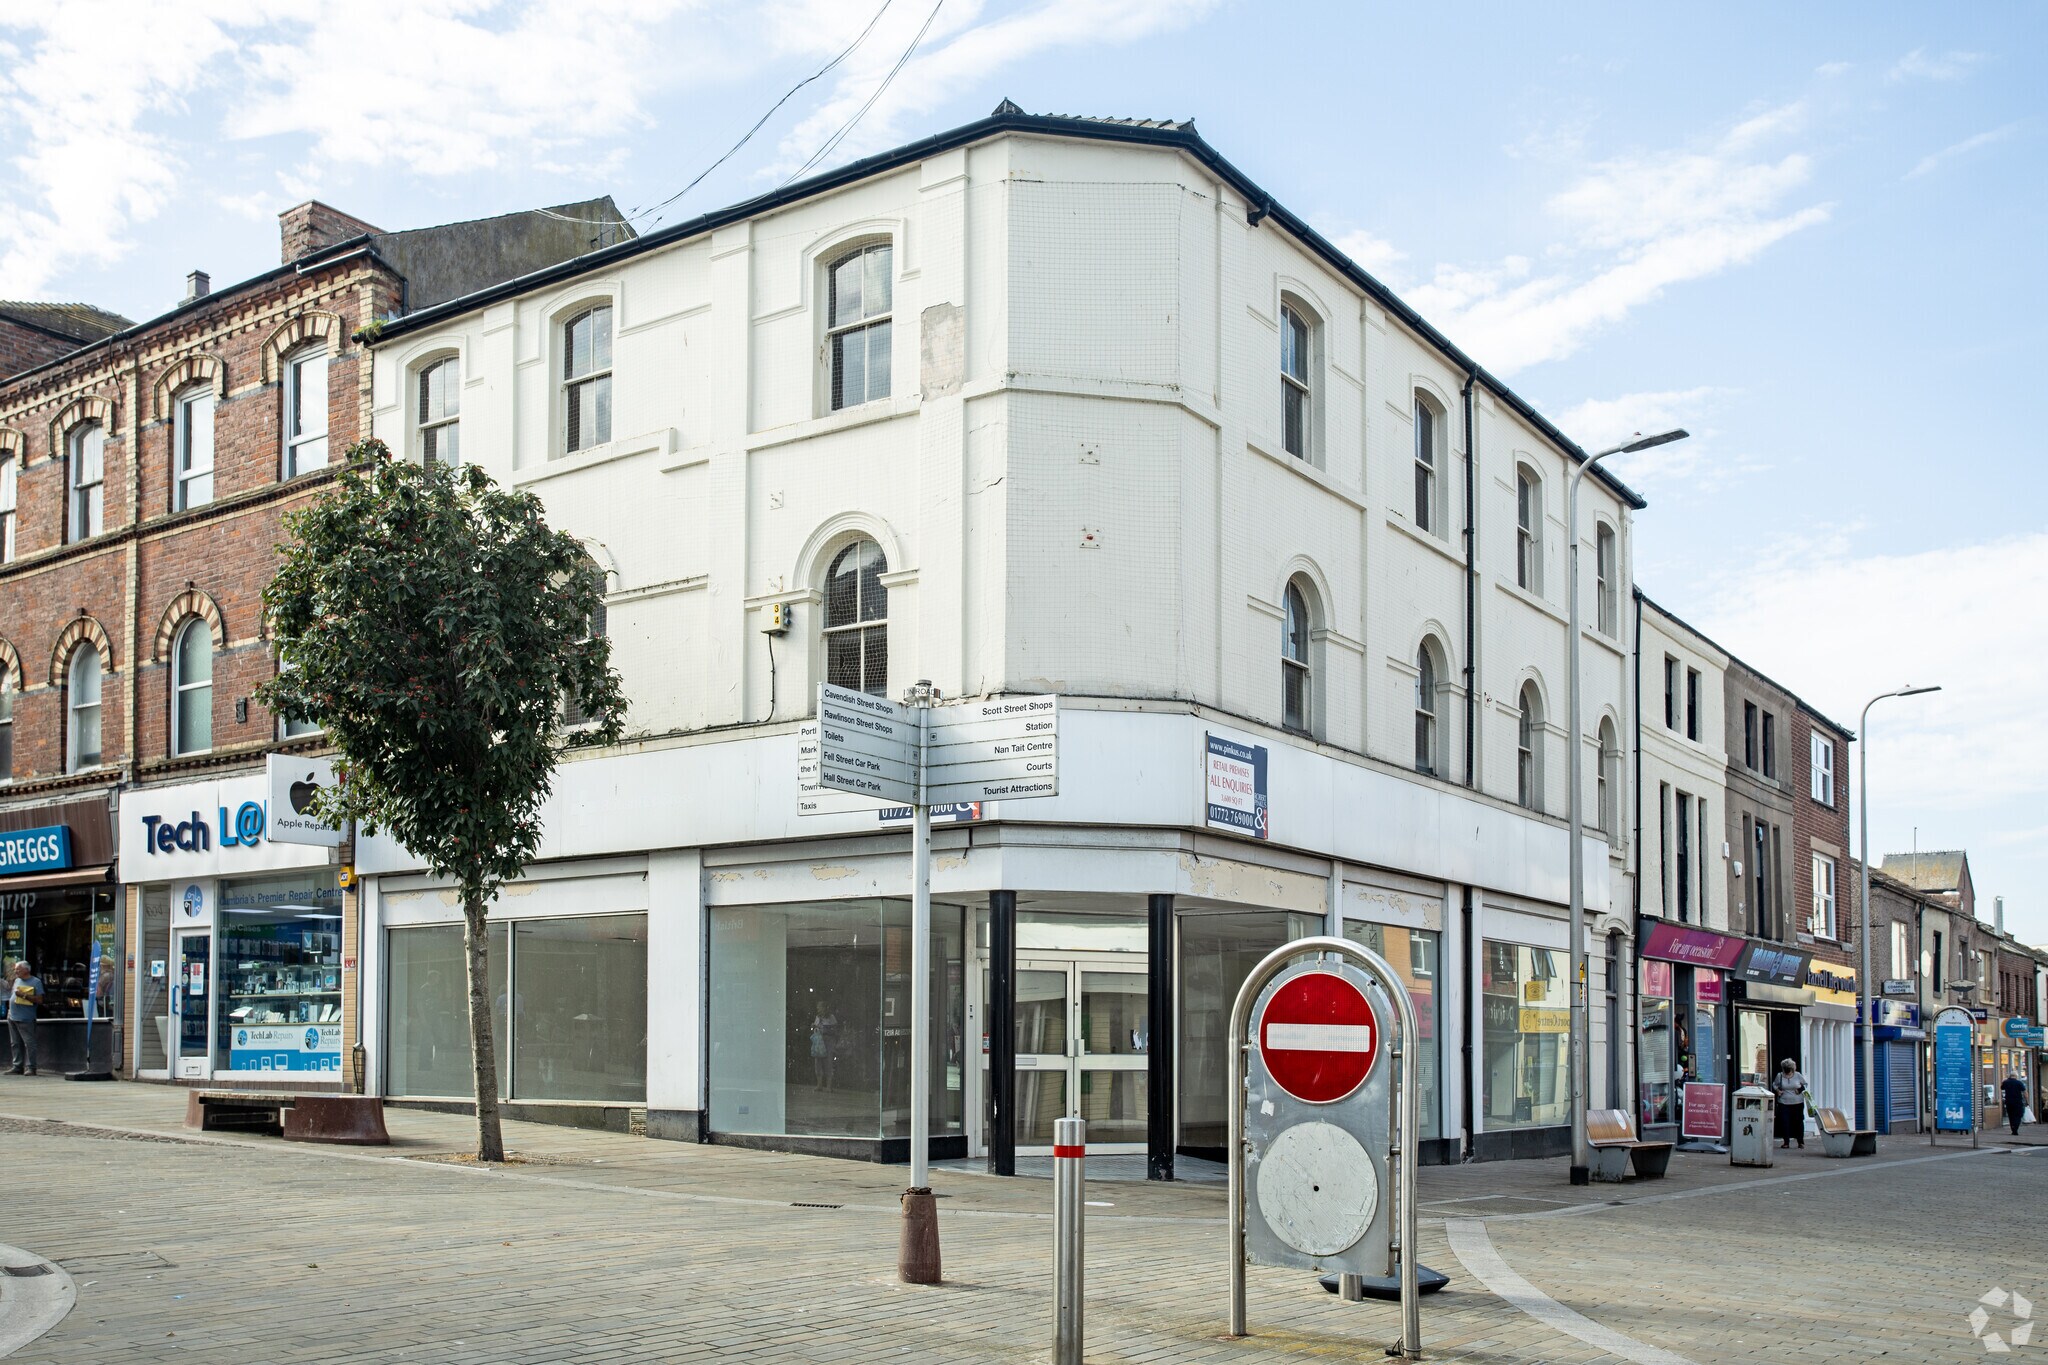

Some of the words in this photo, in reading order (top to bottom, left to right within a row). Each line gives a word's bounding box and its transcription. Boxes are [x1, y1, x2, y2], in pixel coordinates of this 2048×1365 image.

[824, 689, 856, 704] Cavendish
[857, 698, 875, 710] Street
[876, 703, 894, 714] Shops
[982, 706, 1002, 716] Scott
[1004, 704, 1027, 714] Street
[1029, 701, 1053, 711] Shops
[824, 710, 855, 724] Rawlinson
[856, 718, 874, 729] Street
[874, 724, 893, 734] Shops
[1026, 722, 1052, 731] Station
[824, 730, 844, 742] Toilets
[994, 746, 1010, 754] Nan
[1012, 744, 1024, 752] Tait
[1027, 742, 1053, 751] Centre
[1210, 742, 1252, 760] www.pinkus.co.uk
[824, 751, 835, 760] Fell
[836, 754, 854, 765] Street
[855, 759, 866, 768] Car
[867, 762, 880, 771] Park
[1026, 762, 1052, 771] Courts
[1214, 760, 1228, 772] RETAIL
[1230, 764, 1249, 778] PREMISES
[824, 772, 835, 781] Hall
[836, 775, 854, 786] Street
[856, 780, 866, 788] Car
[867, 782, 881, 791] Park
[983, 786, 1008, 795] Tourist
[1010, 783, 1052, 793] Attractions
[1210, 774, 1221, 788] ALL
[1222, 777, 1252, 795] ENQUIRIES
[800, 802, 817, 810] Taxis
[277, 818, 302, 829] Apple
[1210, 806, 1228, 821] 01772
[1231, 810, 1253, 826] 769000
[142, 811, 209, 854] Tech
[219, 800, 267, 847] L@
[220, 894, 255, 905] Cumbria's
[258, 892, 286, 904] Premier
[289, 889, 313, 901] Repair
[316, 887, 343, 899] Centre
[1669, 938, 1680, 954] For
[1679, 943, 1690, 958] any
[1690, 944, 1713, 959] occasion
[250, 1031, 272, 1040] TechLab
[273, 1031, 293, 1040] Repairs
[321, 1028, 340, 1036] TechLab
[320, 1037, 340, 1046] Repairs
[1945, 1107, 1963, 1120] bid
